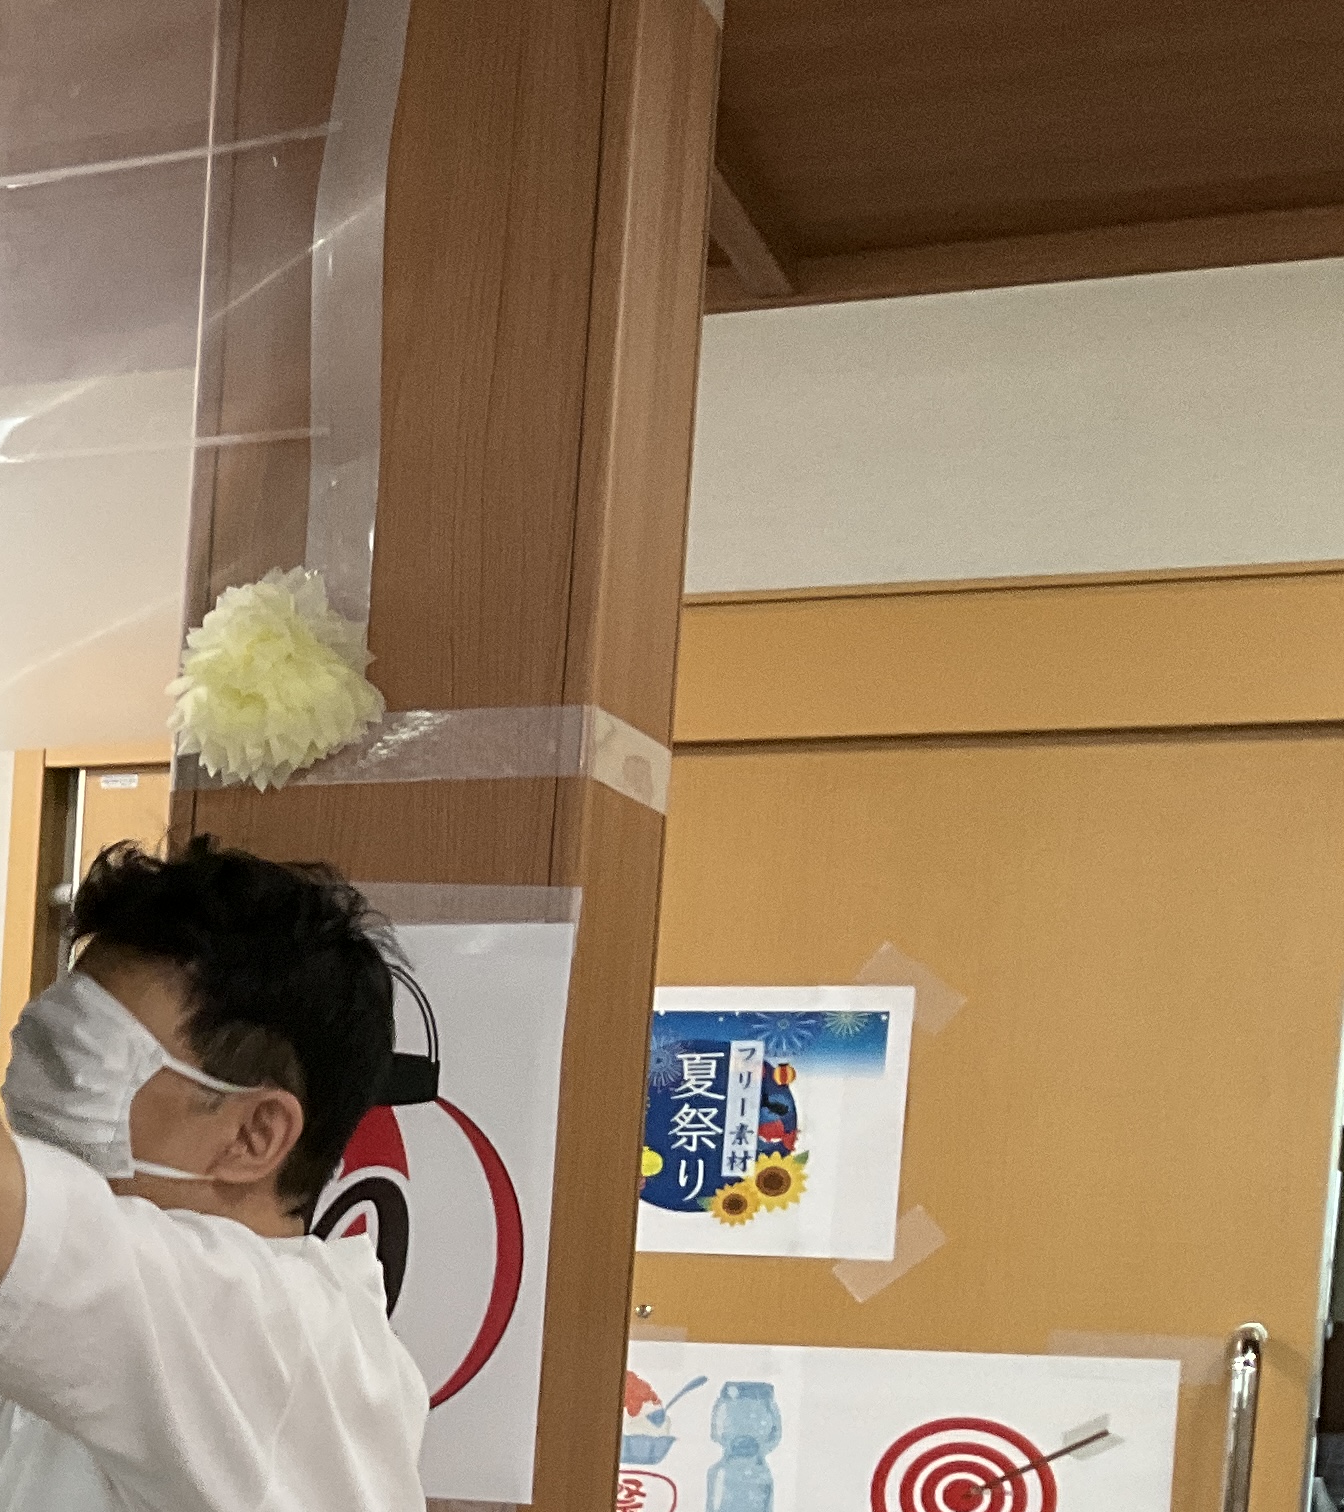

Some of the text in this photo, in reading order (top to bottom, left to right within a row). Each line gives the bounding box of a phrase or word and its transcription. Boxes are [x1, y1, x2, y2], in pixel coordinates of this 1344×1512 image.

[667, 1050, 727, 1202] 夏祭り
[725, 1047, 758, 1173] フリー素材
